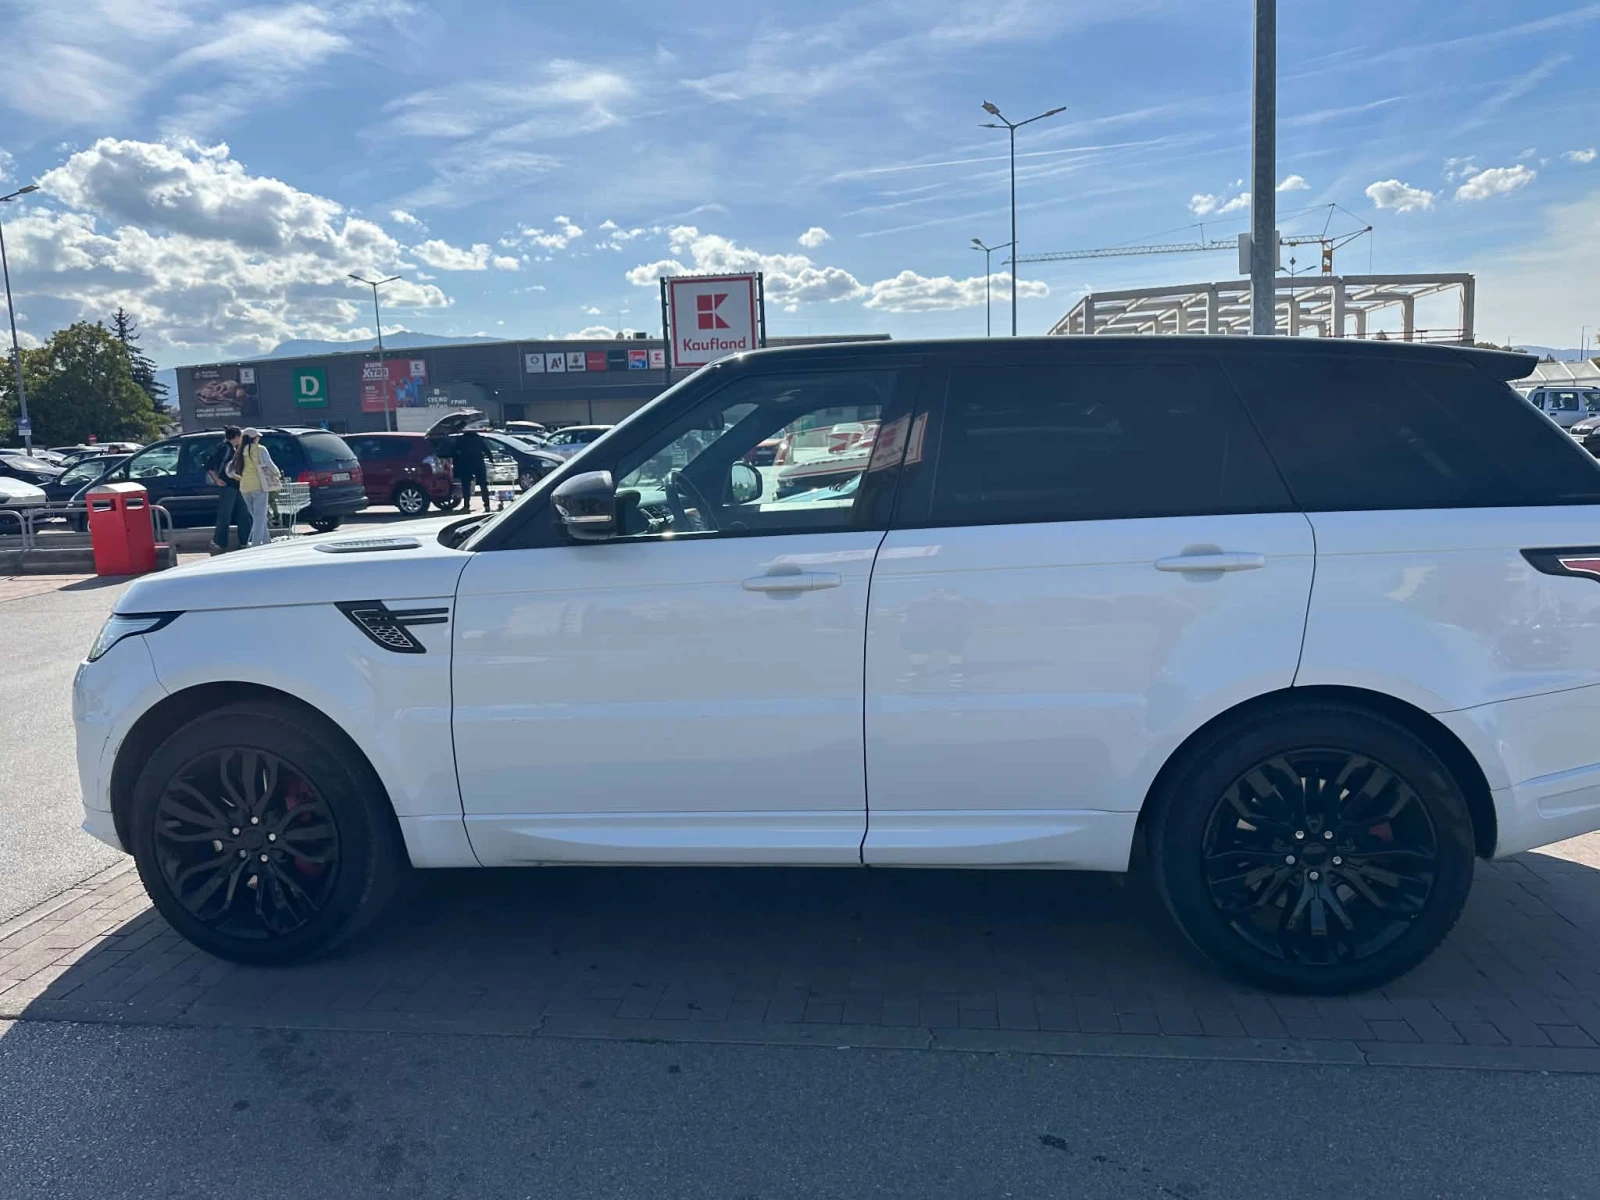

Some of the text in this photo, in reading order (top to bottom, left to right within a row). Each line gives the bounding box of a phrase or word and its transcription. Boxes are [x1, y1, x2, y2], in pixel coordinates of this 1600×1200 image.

[683, 336, 746, 351] Kaufland
[550, 355, 562, 369] A1
[299, 375, 320, 396] D
